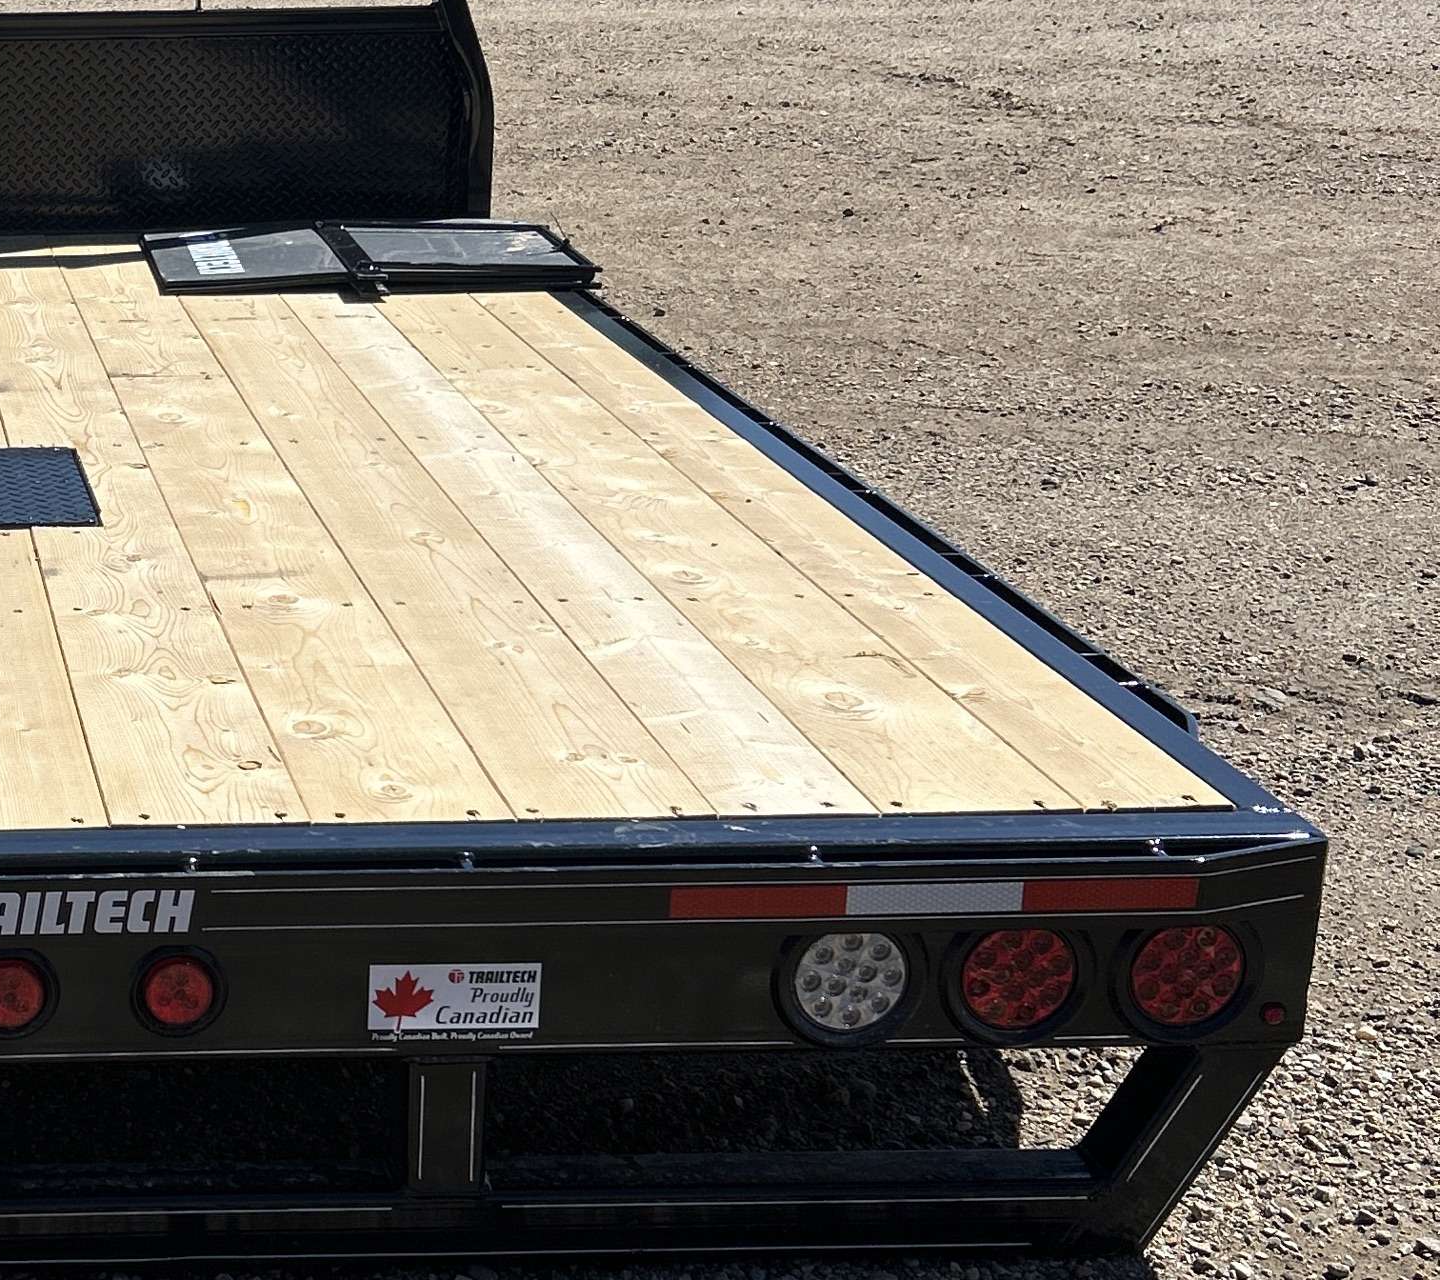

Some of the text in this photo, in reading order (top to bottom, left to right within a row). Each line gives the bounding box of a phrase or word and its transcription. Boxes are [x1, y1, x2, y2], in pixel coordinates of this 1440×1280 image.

[468, 970, 538, 984] TRAILTECH
[470, 987, 535, 1008] Proudly
[435, 1005, 534, 1024] Canadian
